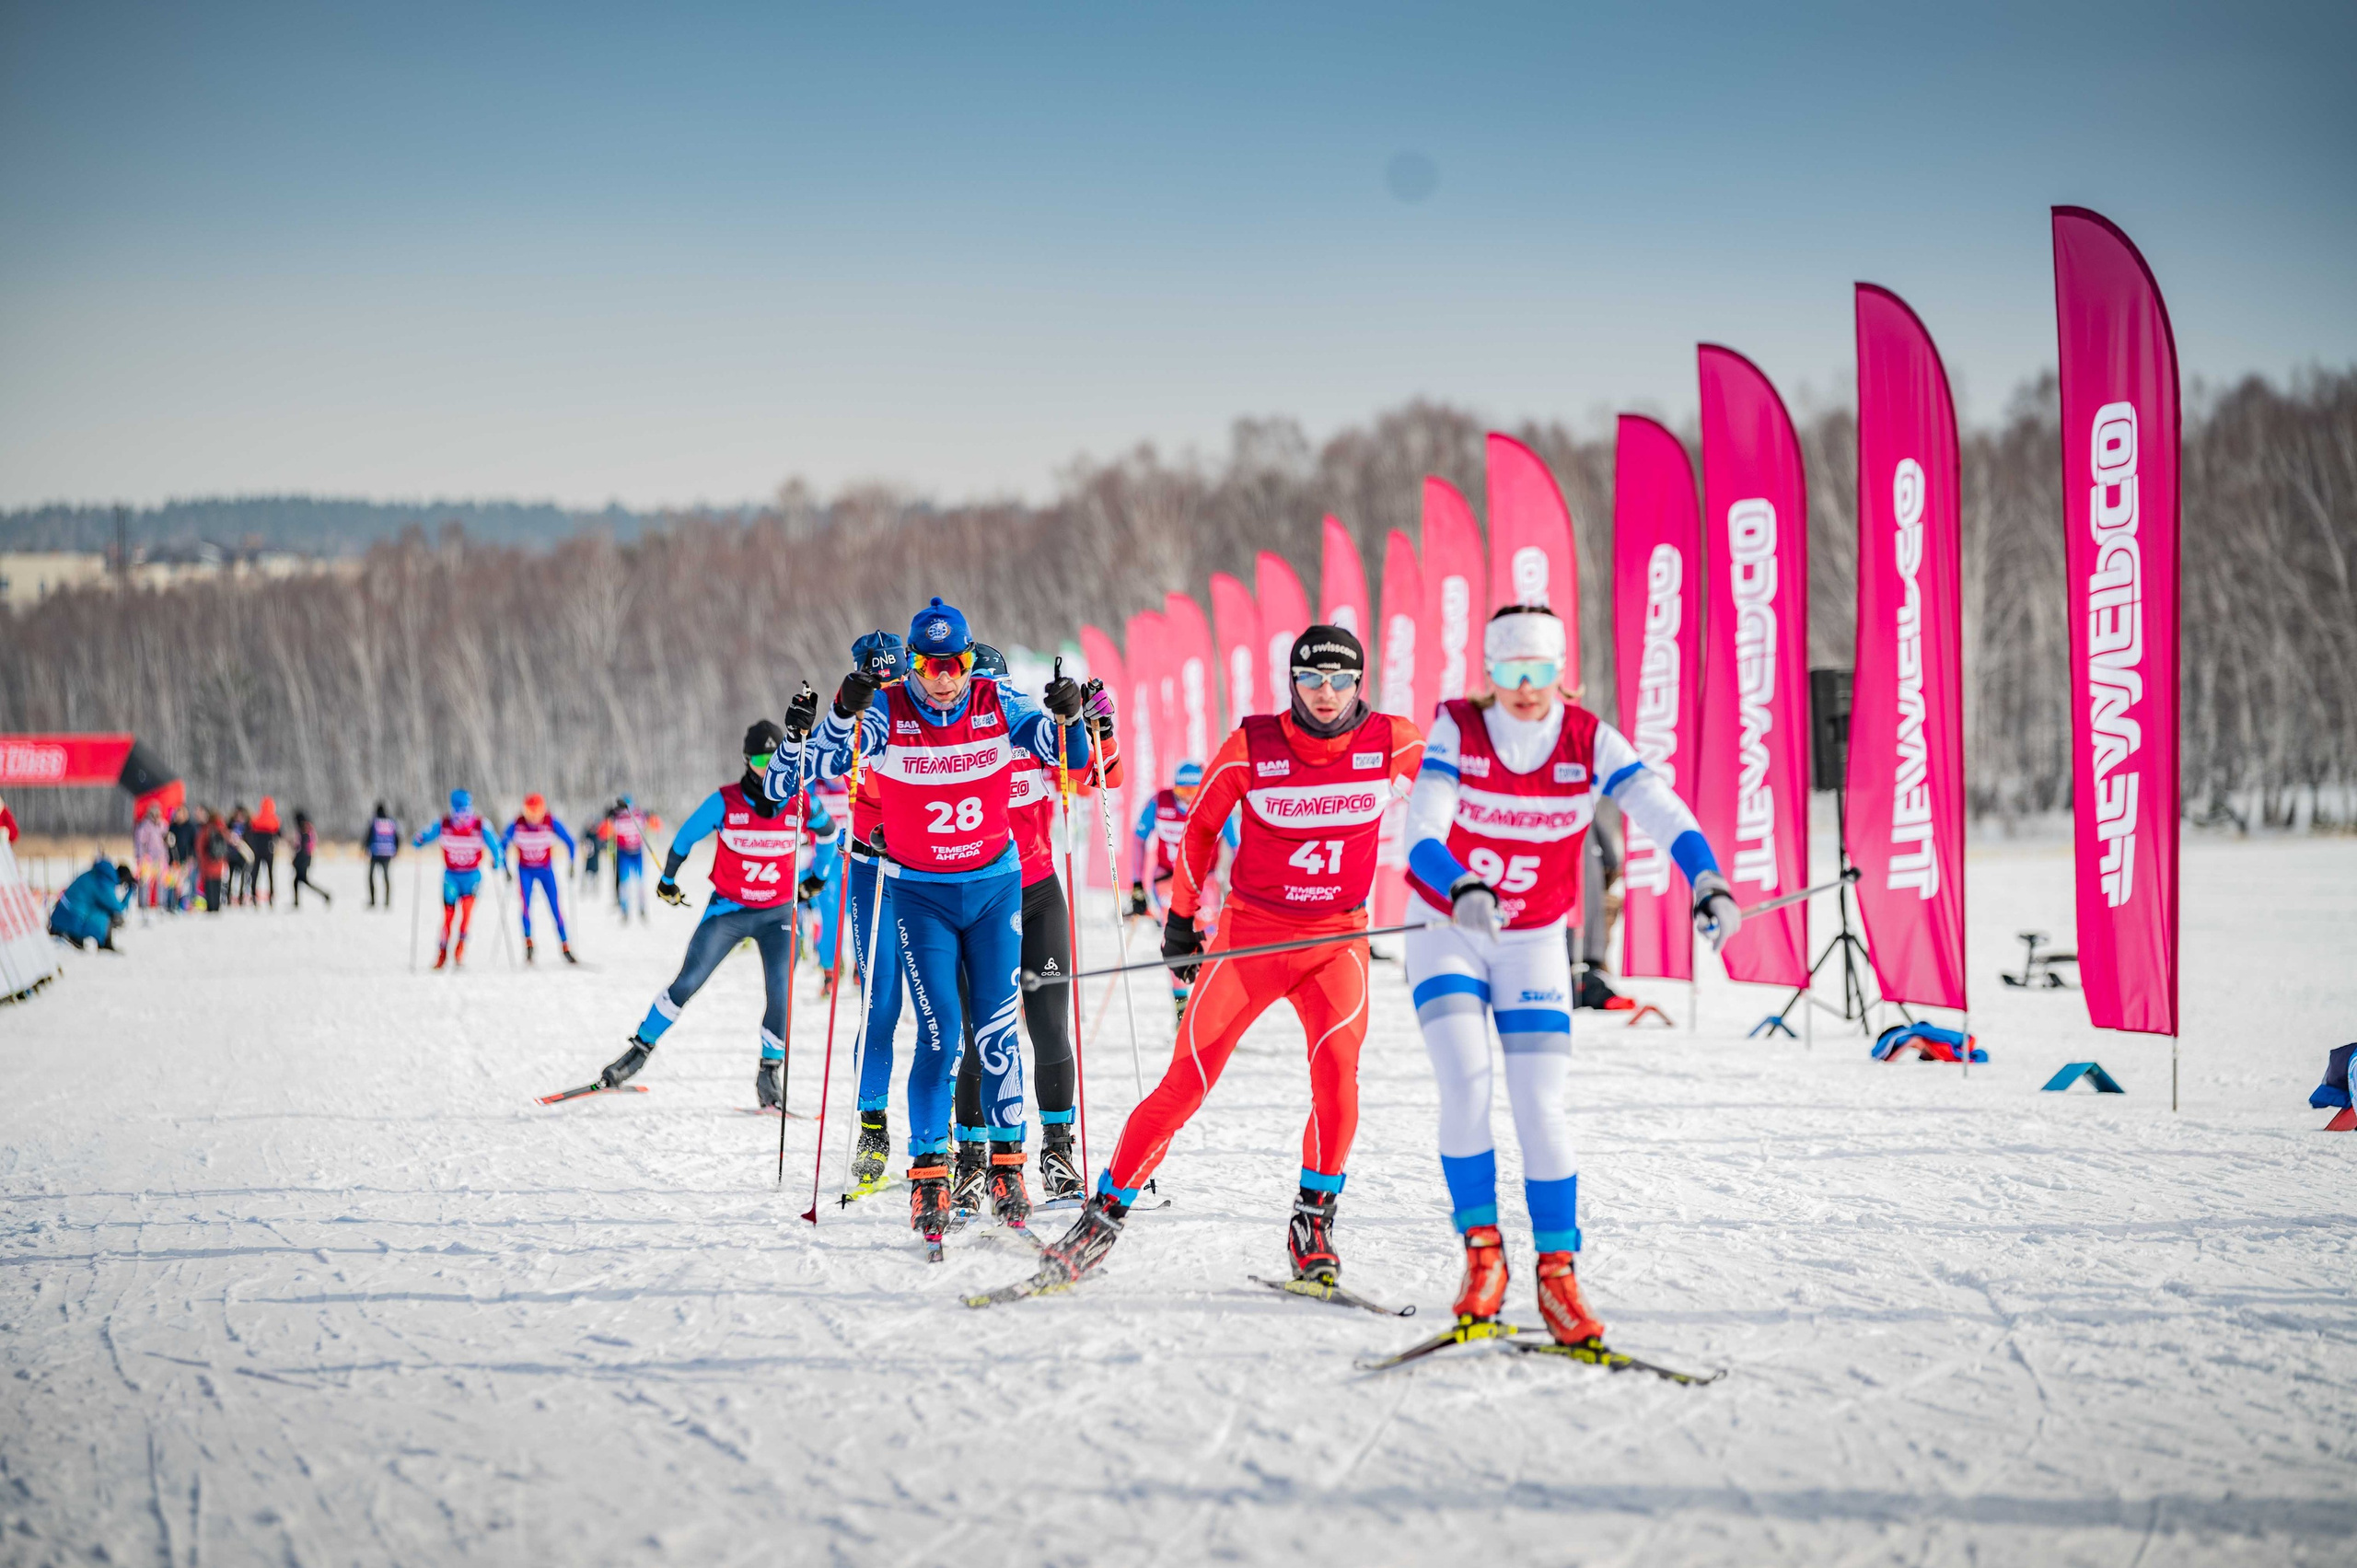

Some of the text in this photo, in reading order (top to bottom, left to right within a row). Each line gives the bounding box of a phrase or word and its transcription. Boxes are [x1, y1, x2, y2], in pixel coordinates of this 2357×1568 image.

[872, 650, 897, 669] DNB
[1312, 641, 1357, 661] swisscom
[924, 796, 984, 834] 28
[931, 840, 984, 854] ТЕМЕРСО
[935, 849, 981, 861] АНГАРА
[1288, 840, 1345, 875] 41
[741, 860, 781, 884] 74
[1469, 847, 1541, 893] 95
[897, 918, 941, 1051] LADA MARATHON TEAM
